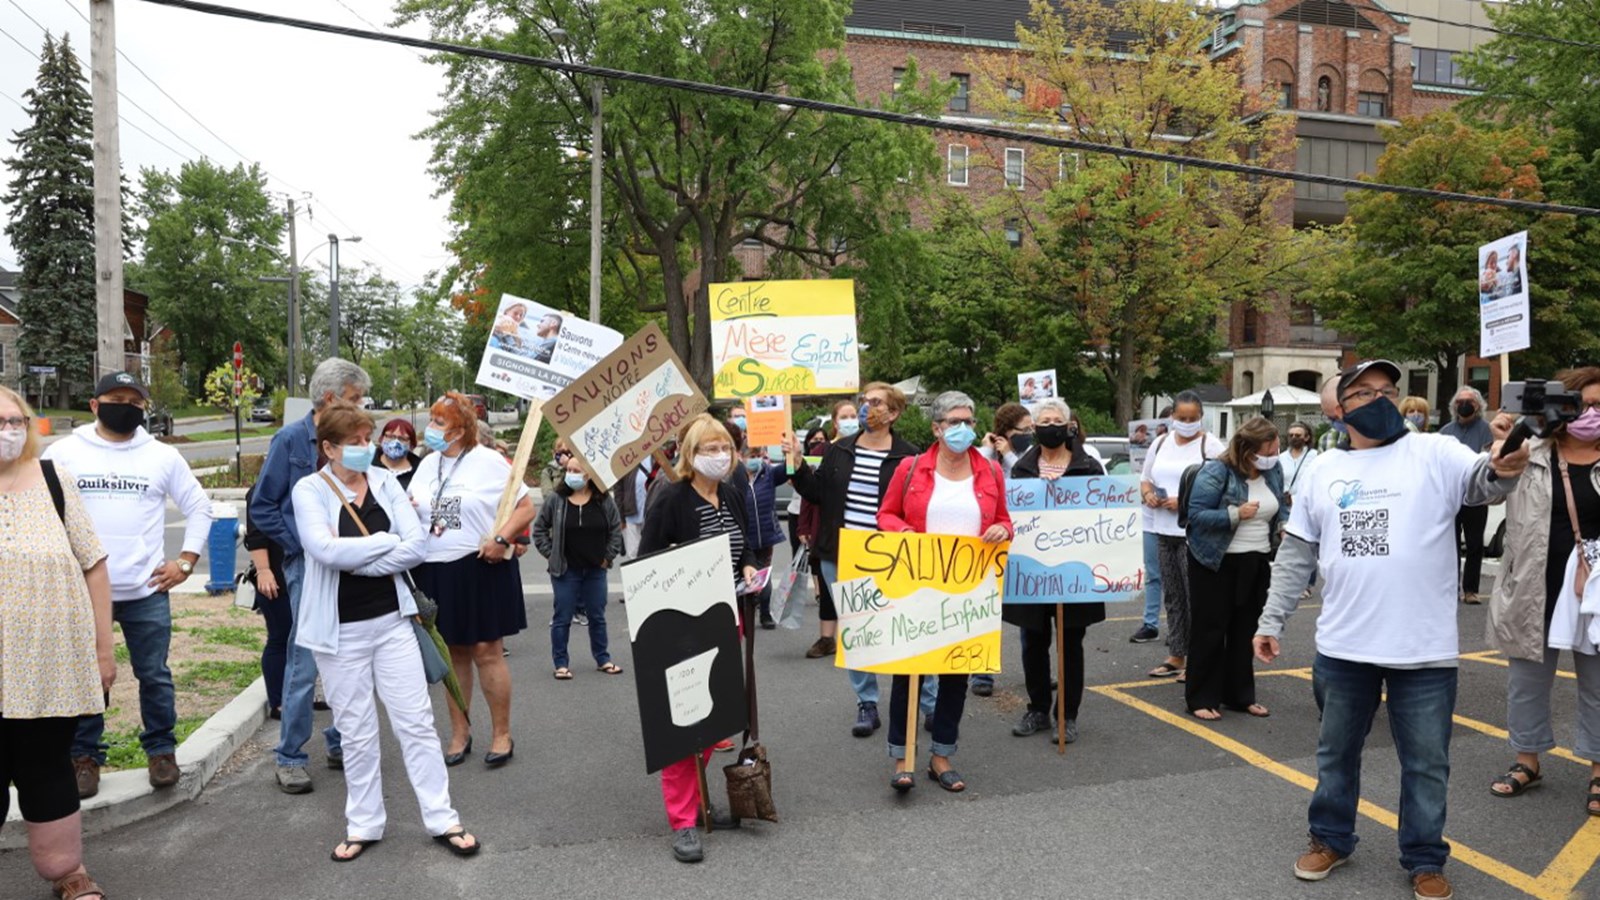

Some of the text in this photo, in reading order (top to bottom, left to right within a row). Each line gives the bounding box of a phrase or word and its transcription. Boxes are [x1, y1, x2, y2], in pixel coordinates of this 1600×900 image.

[716, 284, 773, 316] Centre
[560, 326, 594, 347] Sauvons
[721, 322, 855, 373] Mère Enfant
[496, 357, 537, 377] SIGNONS
[538, 369, 551, 380] LA
[555, 333, 659, 424] SAUVONS
[602, 367, 643, 408] NOTRE
[77, 478, 149, 492] Quiksilver
[1085, 478, 1138, 508] Enfant
[1034, 512, 1137, 552] essentiel
[854, 533, 1008, 585] SAUVONS
[1067, 575, 1087, 595] du
